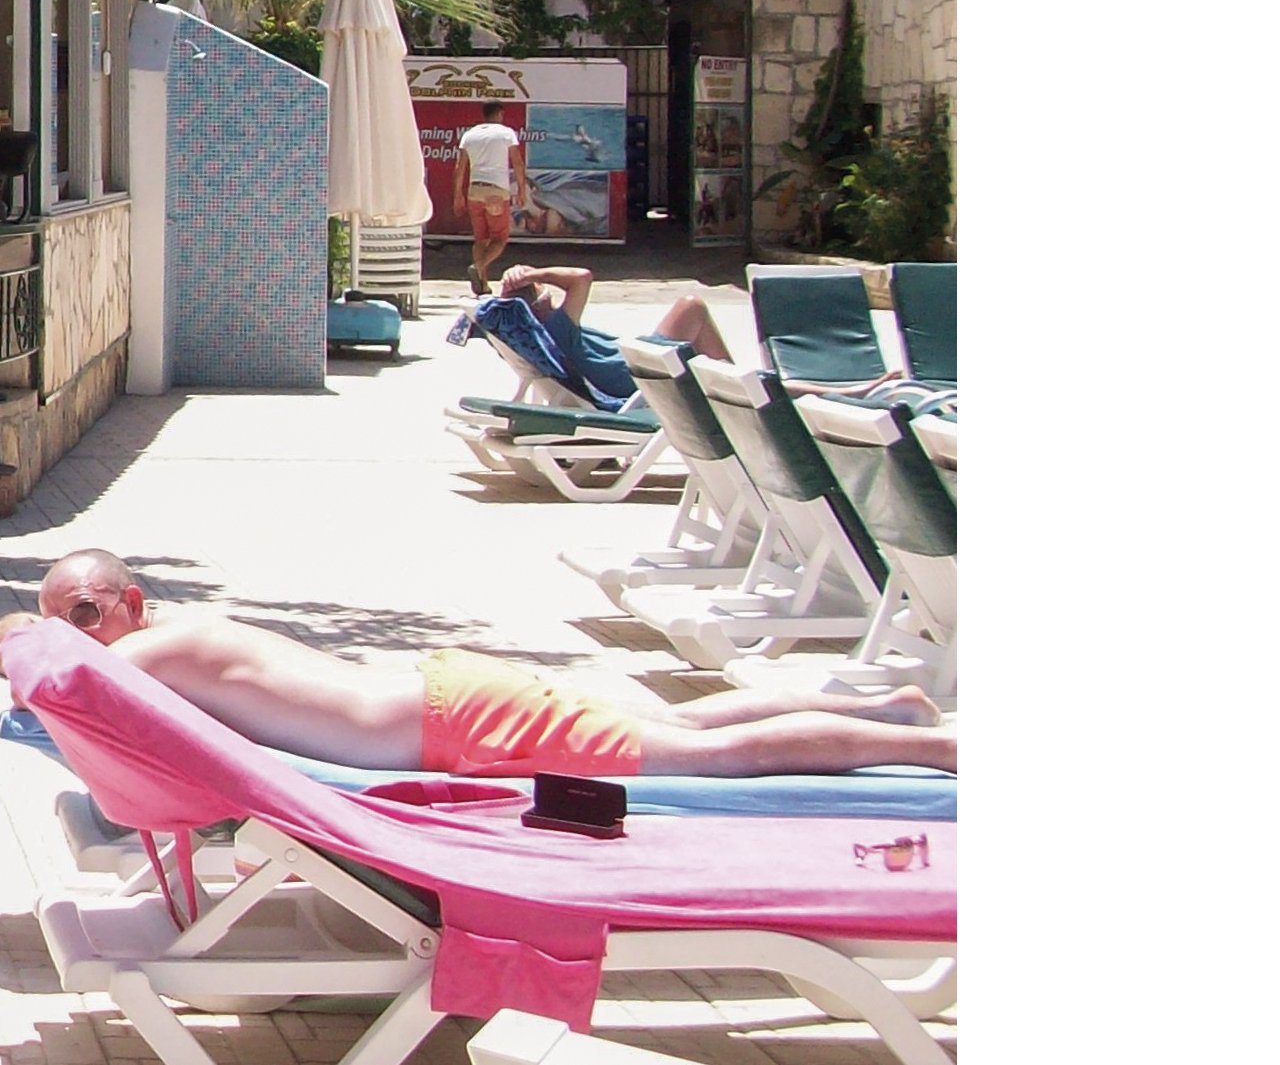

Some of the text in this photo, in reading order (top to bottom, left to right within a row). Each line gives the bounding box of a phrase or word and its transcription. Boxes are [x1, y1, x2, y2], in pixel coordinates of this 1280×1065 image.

[701, 59, 712, 70] NO
[411, 86, 515, 98] DOLPHIN PARK
